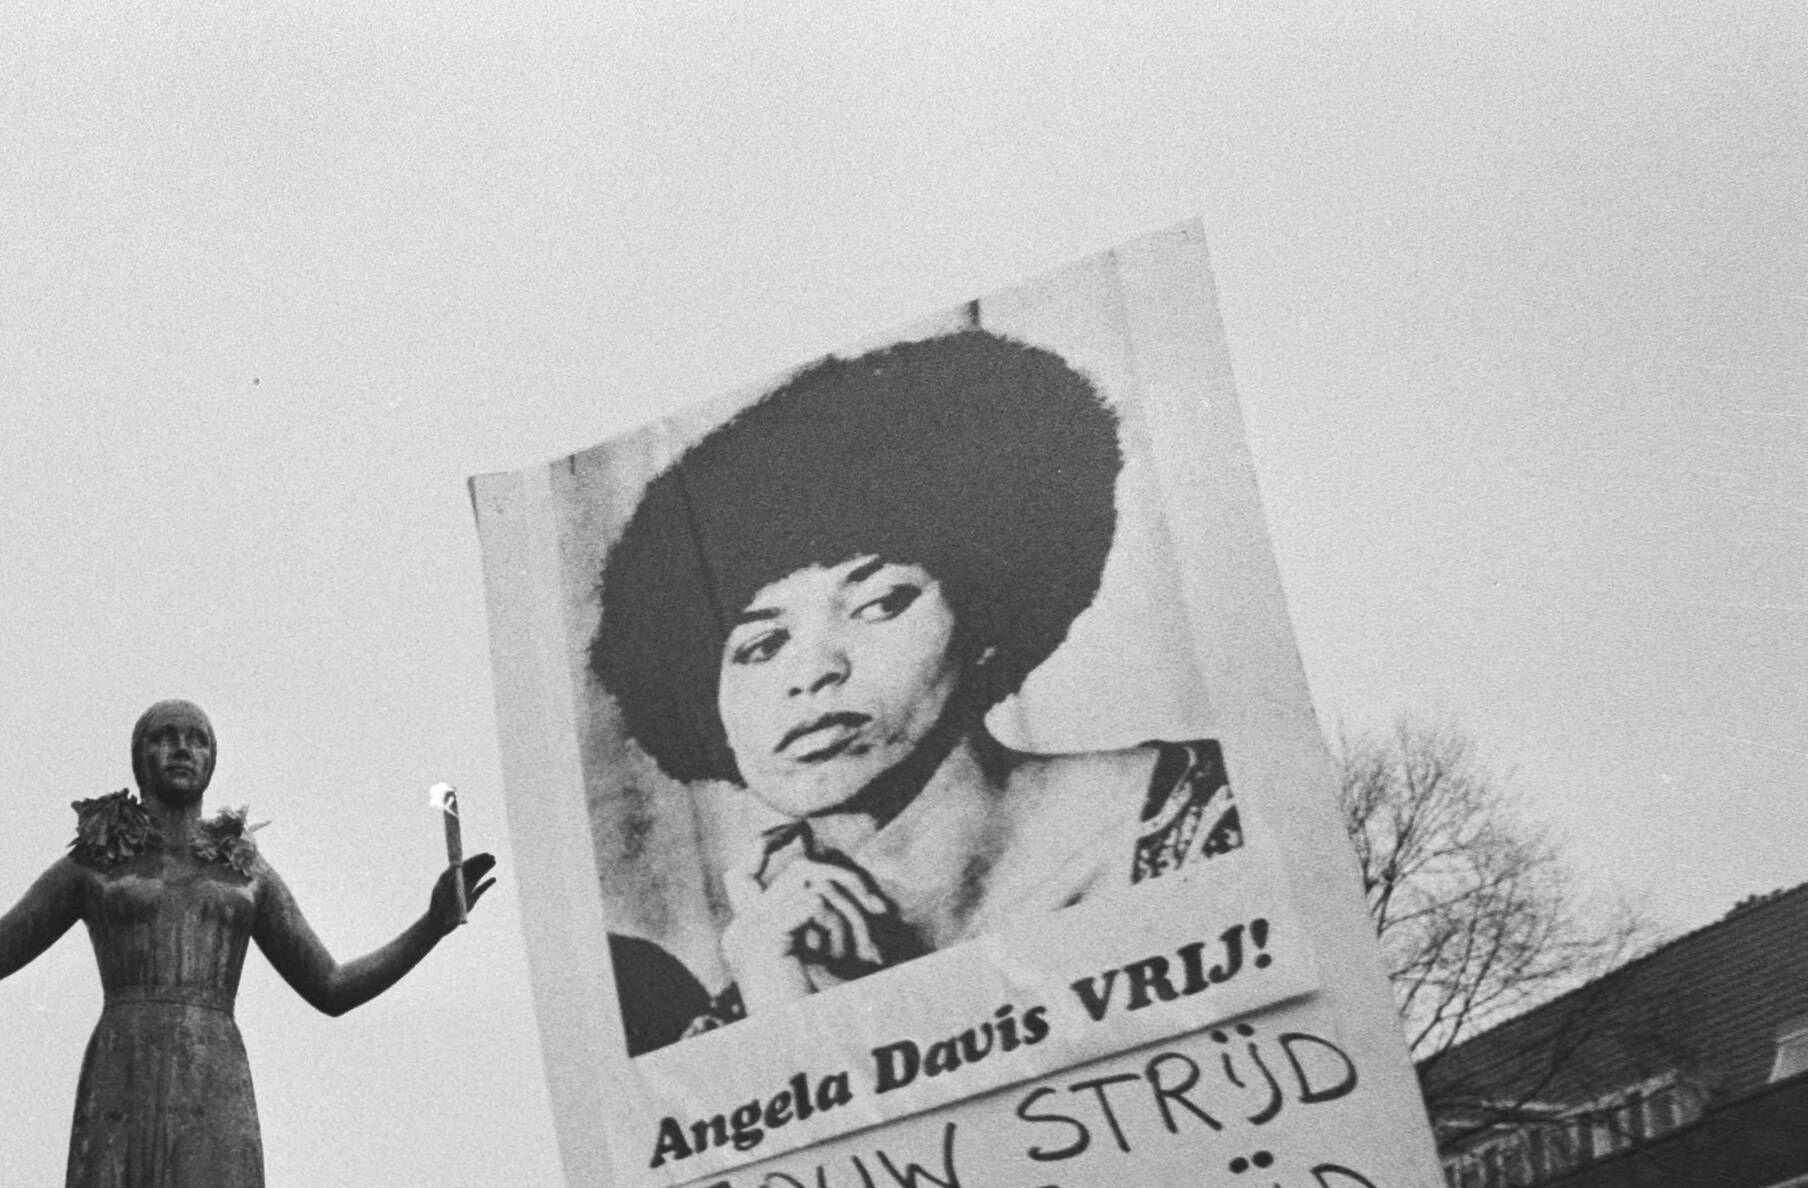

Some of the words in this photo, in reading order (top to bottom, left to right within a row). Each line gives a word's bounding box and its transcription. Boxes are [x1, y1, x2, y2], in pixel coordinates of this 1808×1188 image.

[648, 1071, 852, 1168] Angela
[872, 1002, 1050, 1096] Davis
[1070, 918, 1273, 1021] VRIJ!
